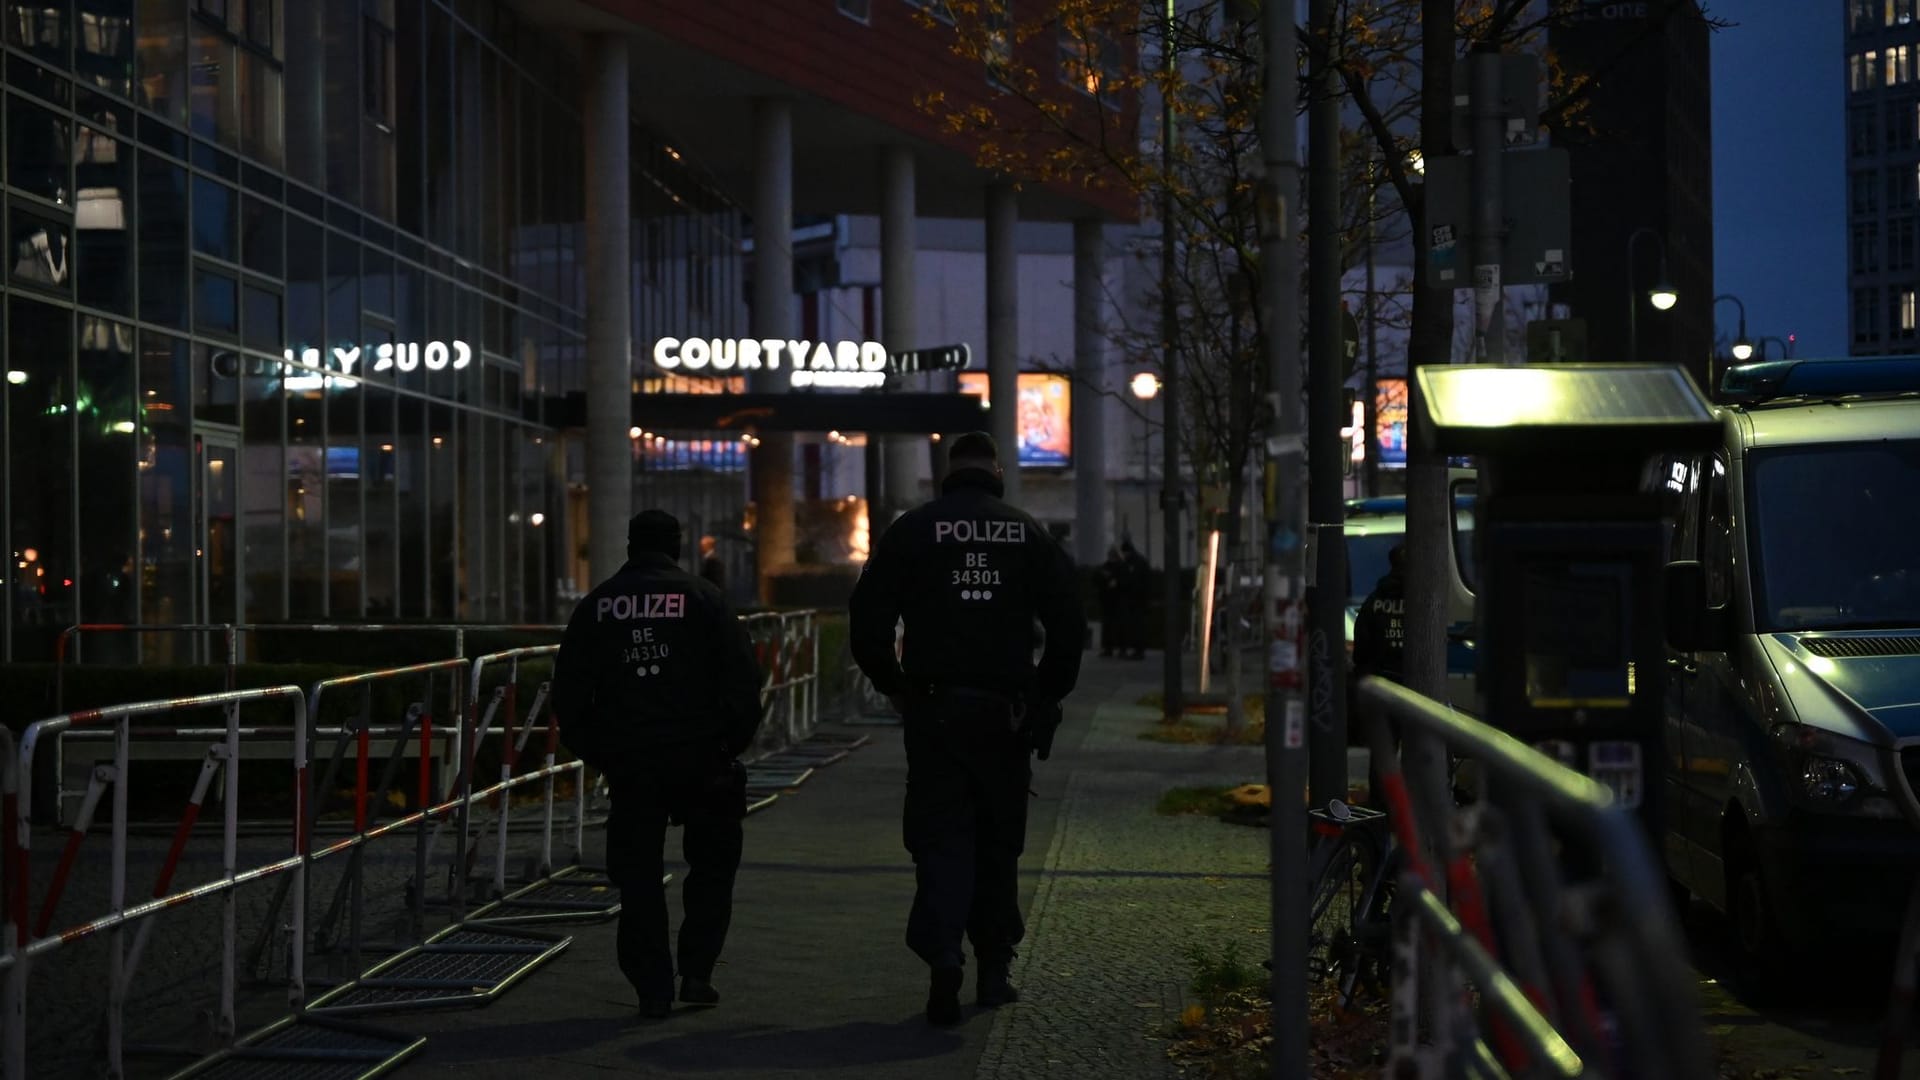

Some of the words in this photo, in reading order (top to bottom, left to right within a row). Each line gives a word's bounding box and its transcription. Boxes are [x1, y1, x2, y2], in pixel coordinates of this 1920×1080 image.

[653, 336, 887, 372] COURTYARD
[935, 519, 1026, 543] POLIZEI
[965, 552, 988, 568] BE
[951, 570, 1001, 585] 34301
[597, 593, 685, 622] POLIZEI
[1373, 599, 1406, 614] POLI
[631, 627, 655, 643] BE
